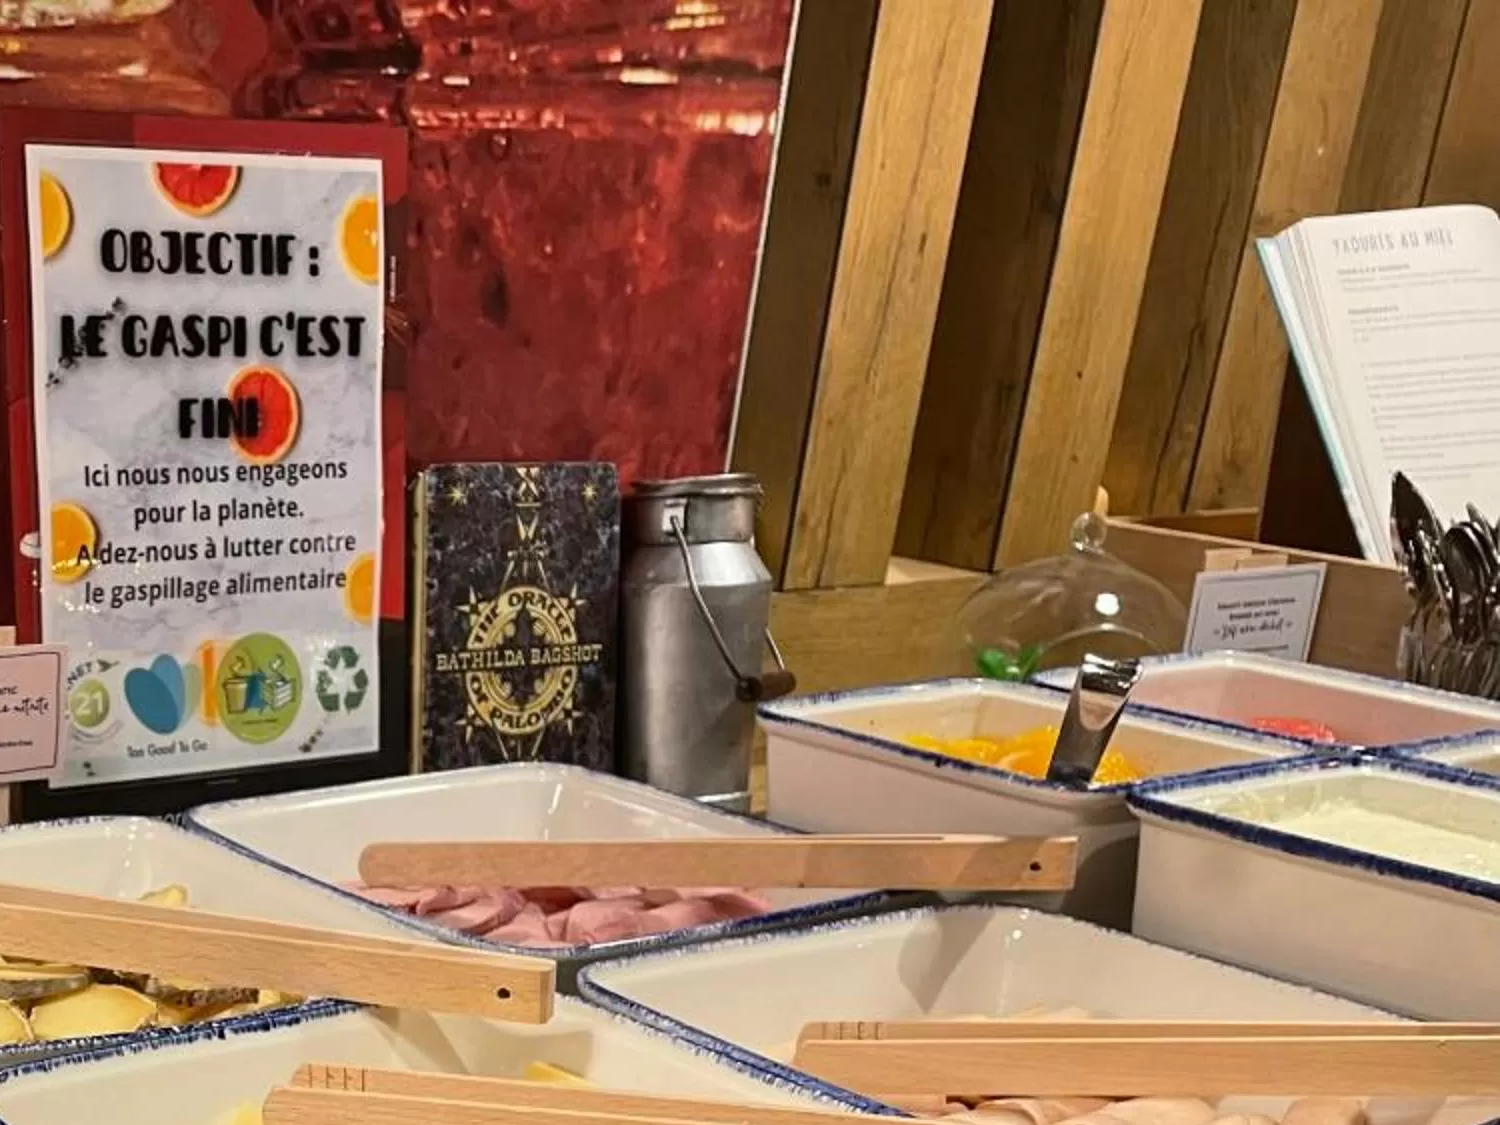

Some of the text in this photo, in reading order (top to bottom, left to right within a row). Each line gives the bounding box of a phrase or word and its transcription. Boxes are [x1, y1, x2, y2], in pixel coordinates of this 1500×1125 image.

[100, 228, 296, 276] OBJECTIF
[59, 311, 366, 358] LE GASPI C'EST
[178, 397, 261, 439] FINI
[84, 458, 347, 487] Ici nous nous engageons
[134, 498, 304, 529] pour la planète.
[76, 533, 356, 566] Aidez-nous à lutter contre
[85, 567, 347, 608] le gaspillage alimentaire
[436, 644, 603, 671] BATHILDA BAGSHOT
[75, 691, 104, 715] 21
